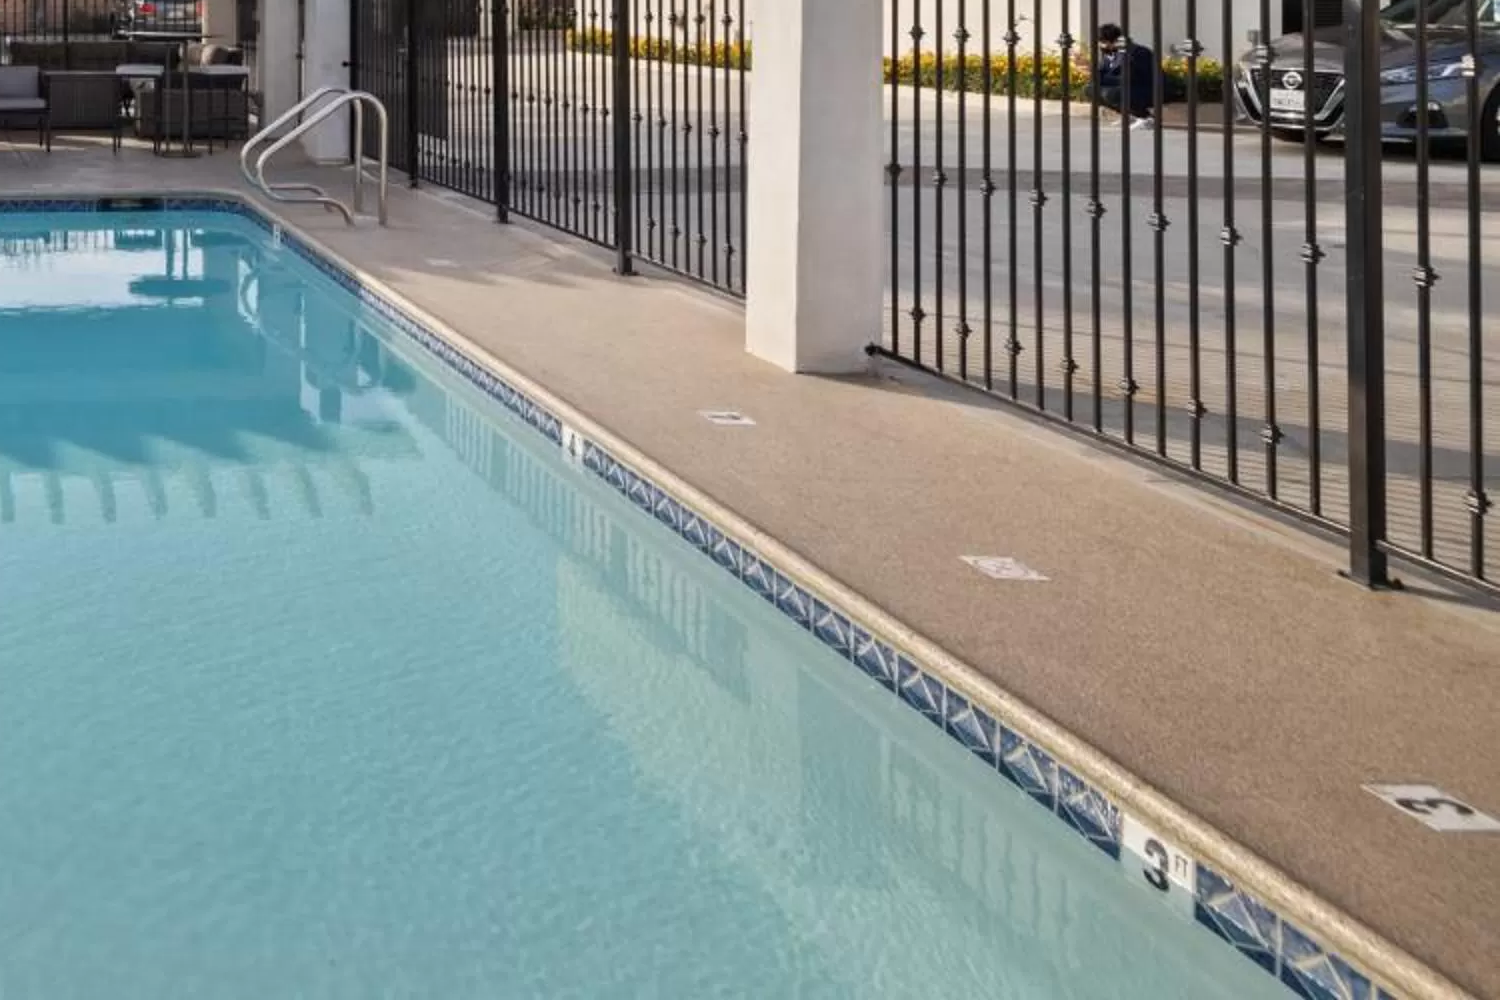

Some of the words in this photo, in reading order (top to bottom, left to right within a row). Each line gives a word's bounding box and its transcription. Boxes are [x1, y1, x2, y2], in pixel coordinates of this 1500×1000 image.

[1395, 798, 1474, 815] 3
[1143, 837, 1170, 893] 3
[1174, 854, 1188, 880] FT
